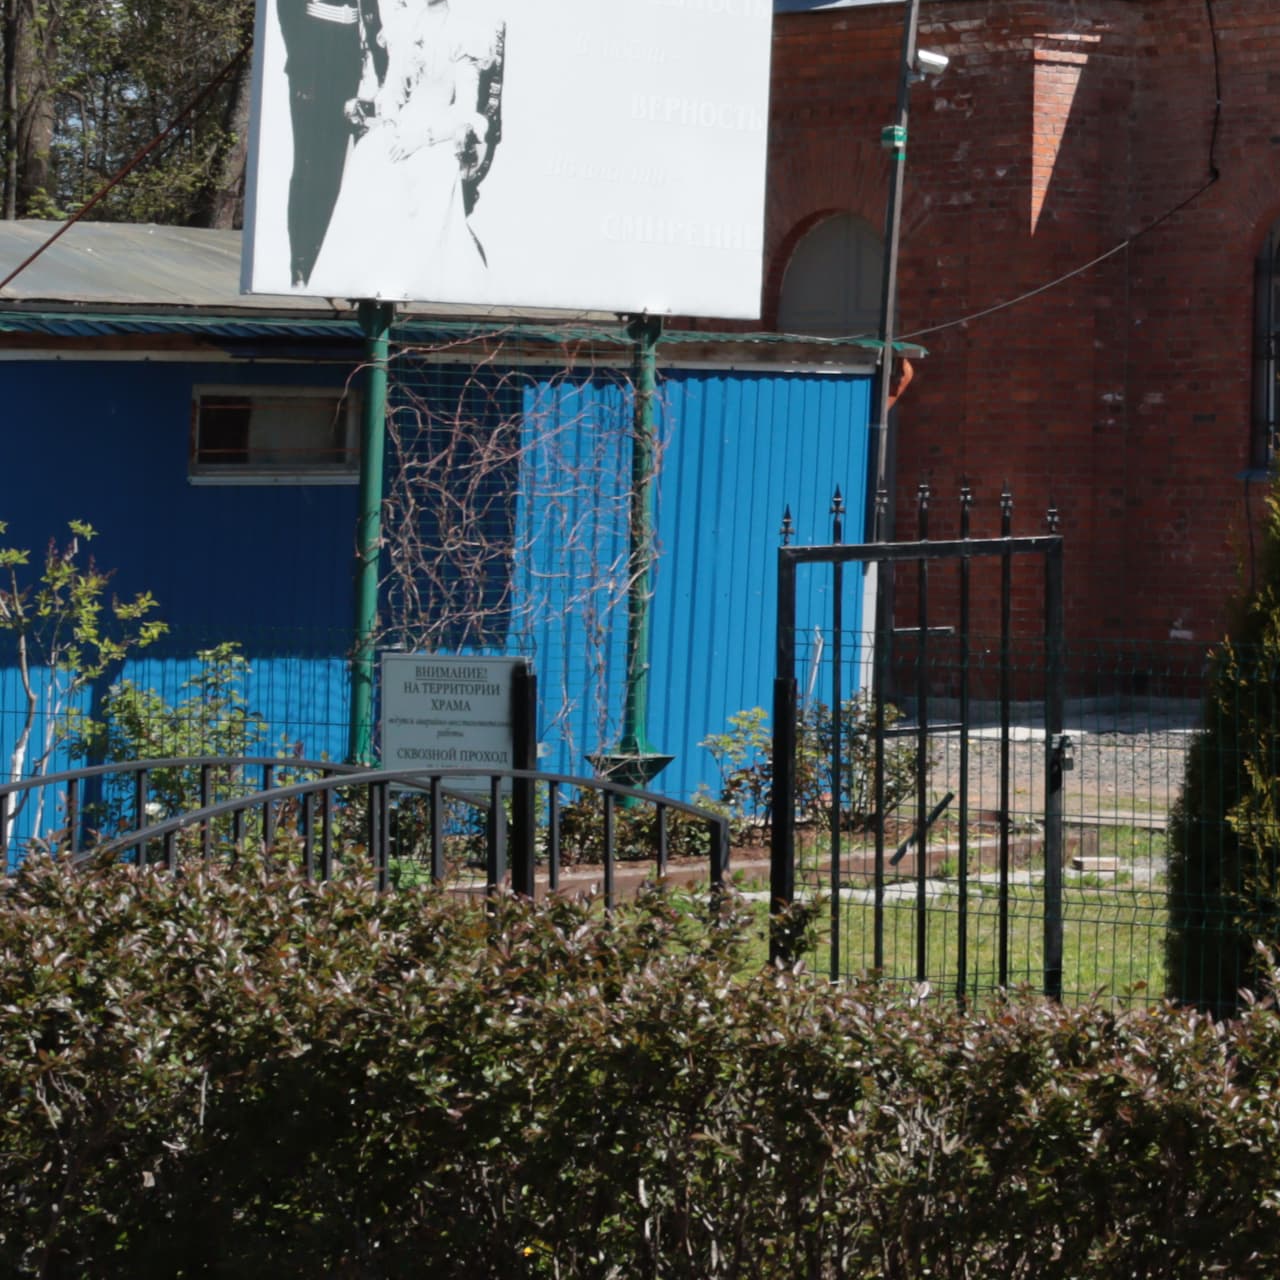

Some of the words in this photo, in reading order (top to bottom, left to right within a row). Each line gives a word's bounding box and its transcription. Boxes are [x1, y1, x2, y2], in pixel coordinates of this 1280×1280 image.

[631, 93, 764, 132] ВЕРНОСТЬ
[415, 665, 488, 681] ВНИМАНИЕ!
[403, 682, 419, 694] НА
[421, 682, 501, 696] ТЕРРИТОРИИ
[431, 699, 471, 712] ХРАМА
[396, 747, 457, 762] СКВОЗНОЙ
[459, 751, 508, 764] ПРОХОД
